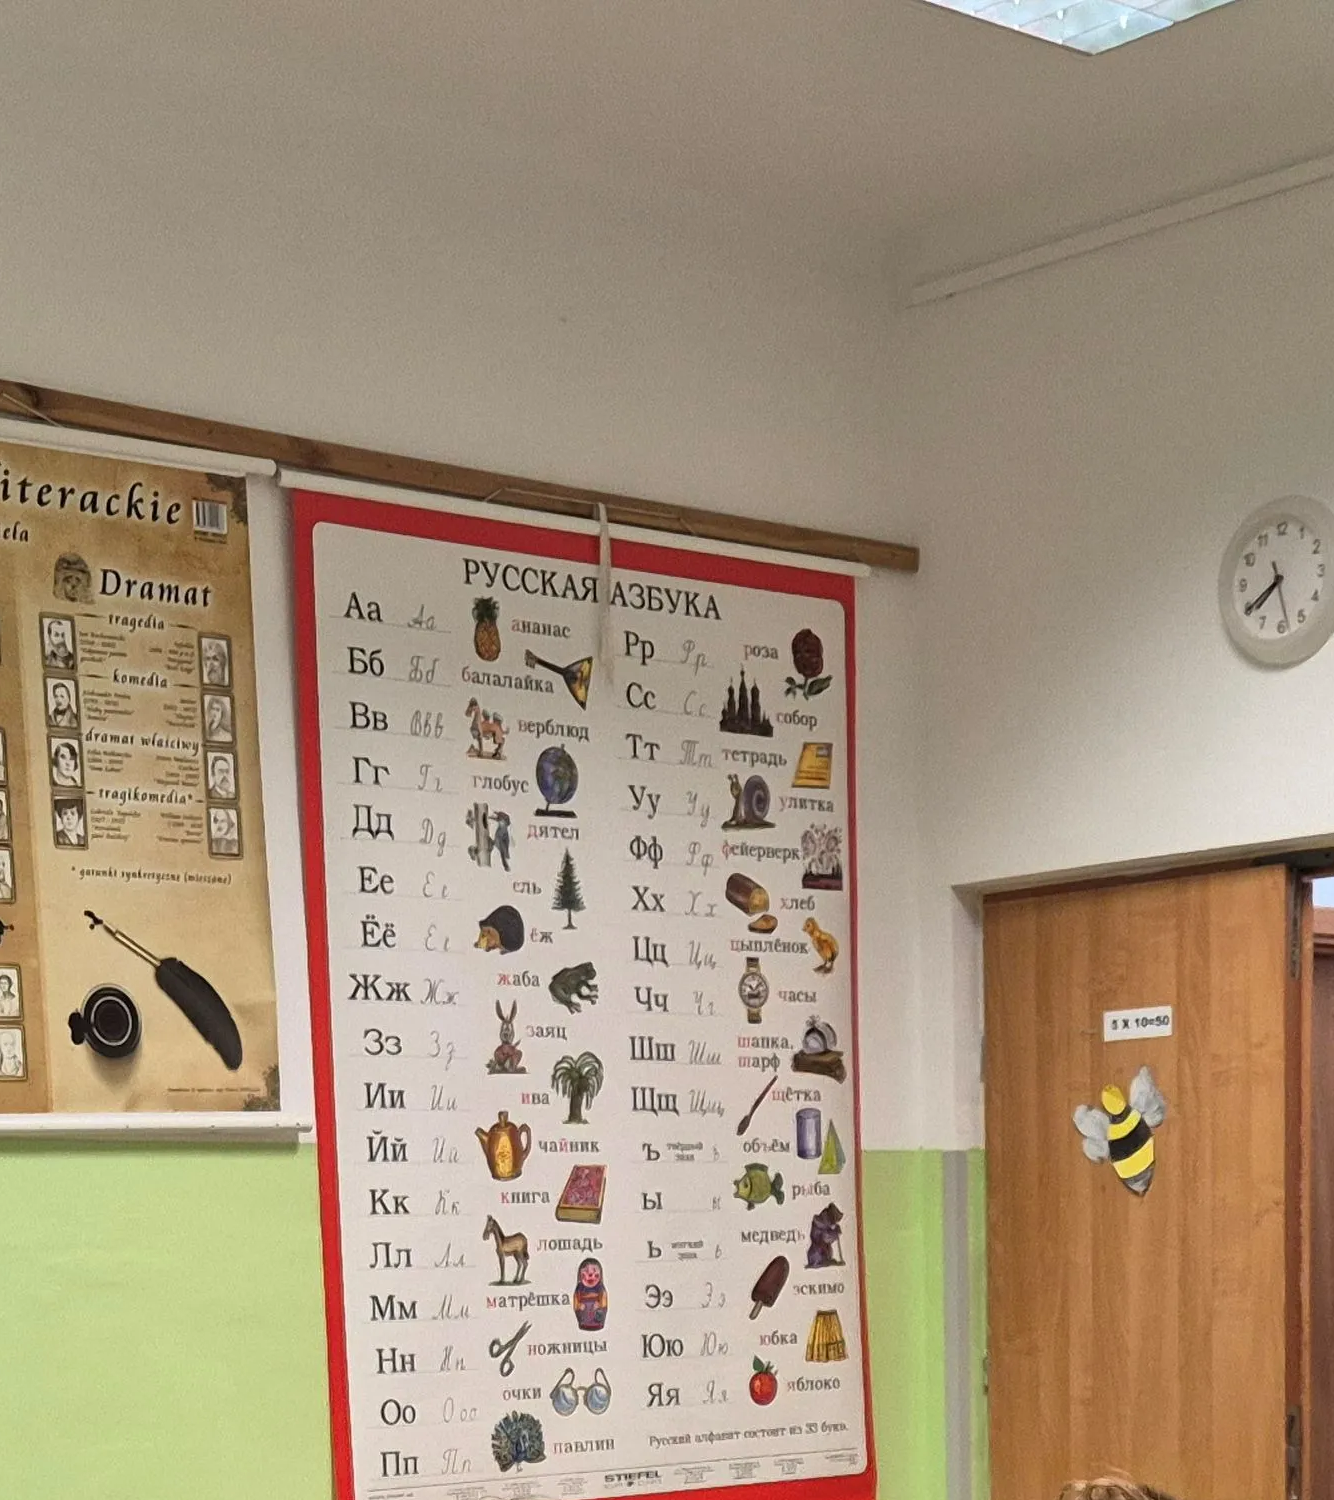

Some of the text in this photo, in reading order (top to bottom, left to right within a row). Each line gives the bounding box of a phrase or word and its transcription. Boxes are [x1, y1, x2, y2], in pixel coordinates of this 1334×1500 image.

[1276, 521, 1288, 536] 12
[1257, 533, 1268, 547] 11
[1312, 539, 1321, 554] 2
[1317, 564, 1325, 577] 3
[99, 568, 212, 608] Dramat
[462, 558, 722, 620] РУССКАЯ АЗБУКА
[1239, 578, 1247, 592] 9
[343, 592, 383, 623] Аа
[1298, 609, 1306, 623] 5
[109, 613, 165, 632] tragedia
[511, 618, 571, 639] ананас
[1259, 616, 1266, 629] 7
[1277, 620, 1286, 634] 6
[623, 631, 655, 666] Рр
[744, 643, 779, 660] роза
[347, 646, 385, 677] Бб
[113, 668, 167, 688] komedia
[461, 666, 555, 694] балалайка
[349, 701, 389, 731] Вв
[777, 709, 818, 731] собор
[85, 728, 135, 744] dramat
[519, 719, 590, 742] верблюд
[625, 733, 660, 761] Тт
[721, 749, 788, 767] тетрадь
[352, 757, 390, 785] Гг
[472, 775, 529, 797] глобус
[628, 784, 661, 819] Уу
[778, 795, 834, 813] улитка
[352, 804, 394, 841] Дд
[527, 824, 580, 841] дятел
[629, 836, 664, 869] Фф
[721, 840, 801, 863] фейерверк
[359, 866, 395, 894] Ее
[513, 880, 542, 895] ель
[631, 886, 666, 913] Хх
[780, 896, 816, 911] хлеб
[361, 915, 397, 948] Ёё
[530, 928, 553, 943] ёж
[632, 936, 668, 967] Цц
[730, 939, 809, 955] цыплёнок
[348, 973, 412, 1001] Жж
[497, 970, 540, 987] жаба
[634, 986, 669, 1012] Чч
[778, 989, 817, 1003] часы
[363, 1029, 403, 1056] Зз
[526, 1024, 568, 1042] заяц
[737, 1035, 793, 1050] шапка,
[629, 1036, 676, 1062] Шш
[738, 1053, 781, 1072] шарф
[364, 1082, 407, 1110] Ии
[521, 1092, 550, 1105] ива
[631, 1087, 680, 1116] Щщ
[771, 1086, 821, 1102] щётка
[367, 1130, 408, 1163] Йй
[538, 1138, 601, 1154] чайник
[743, 1139, 790, 1153] объём
[501, 1191, 550, 1205] книга
[792, 1182, 831, 1200] рыба
[369, 1189, 411, 1215] Кк
[537, 1236, 603, 1252] лошадь
[741, 1228, 806, 1245] медведь
[369, 1242, 413, 1268] Лл
[645, 1284, 674, 1309] Ээ
[793, 1281, 845, 1296] эскимо
[370, 1295, 418, 1321] Мм
[486, 1292, 571, 1311] матрёшка
[642, 1333, 684, 1359] Юю
[759, 1330, 798, 1345] юбка
[527, 1340, 608, 1357] ножницы
[375, 1348, 417, 1374] Нн
[502, 1386, 542, 1401] очки
[787, 1377, 841, 1392] яблоко
[647, 1383, 681, 1407] Яя
[553, 1438, 615, 1455] павлин
[380, 1451, 420, 1477] Пп
[603, 1469, 662, 1484] STIEFEL
